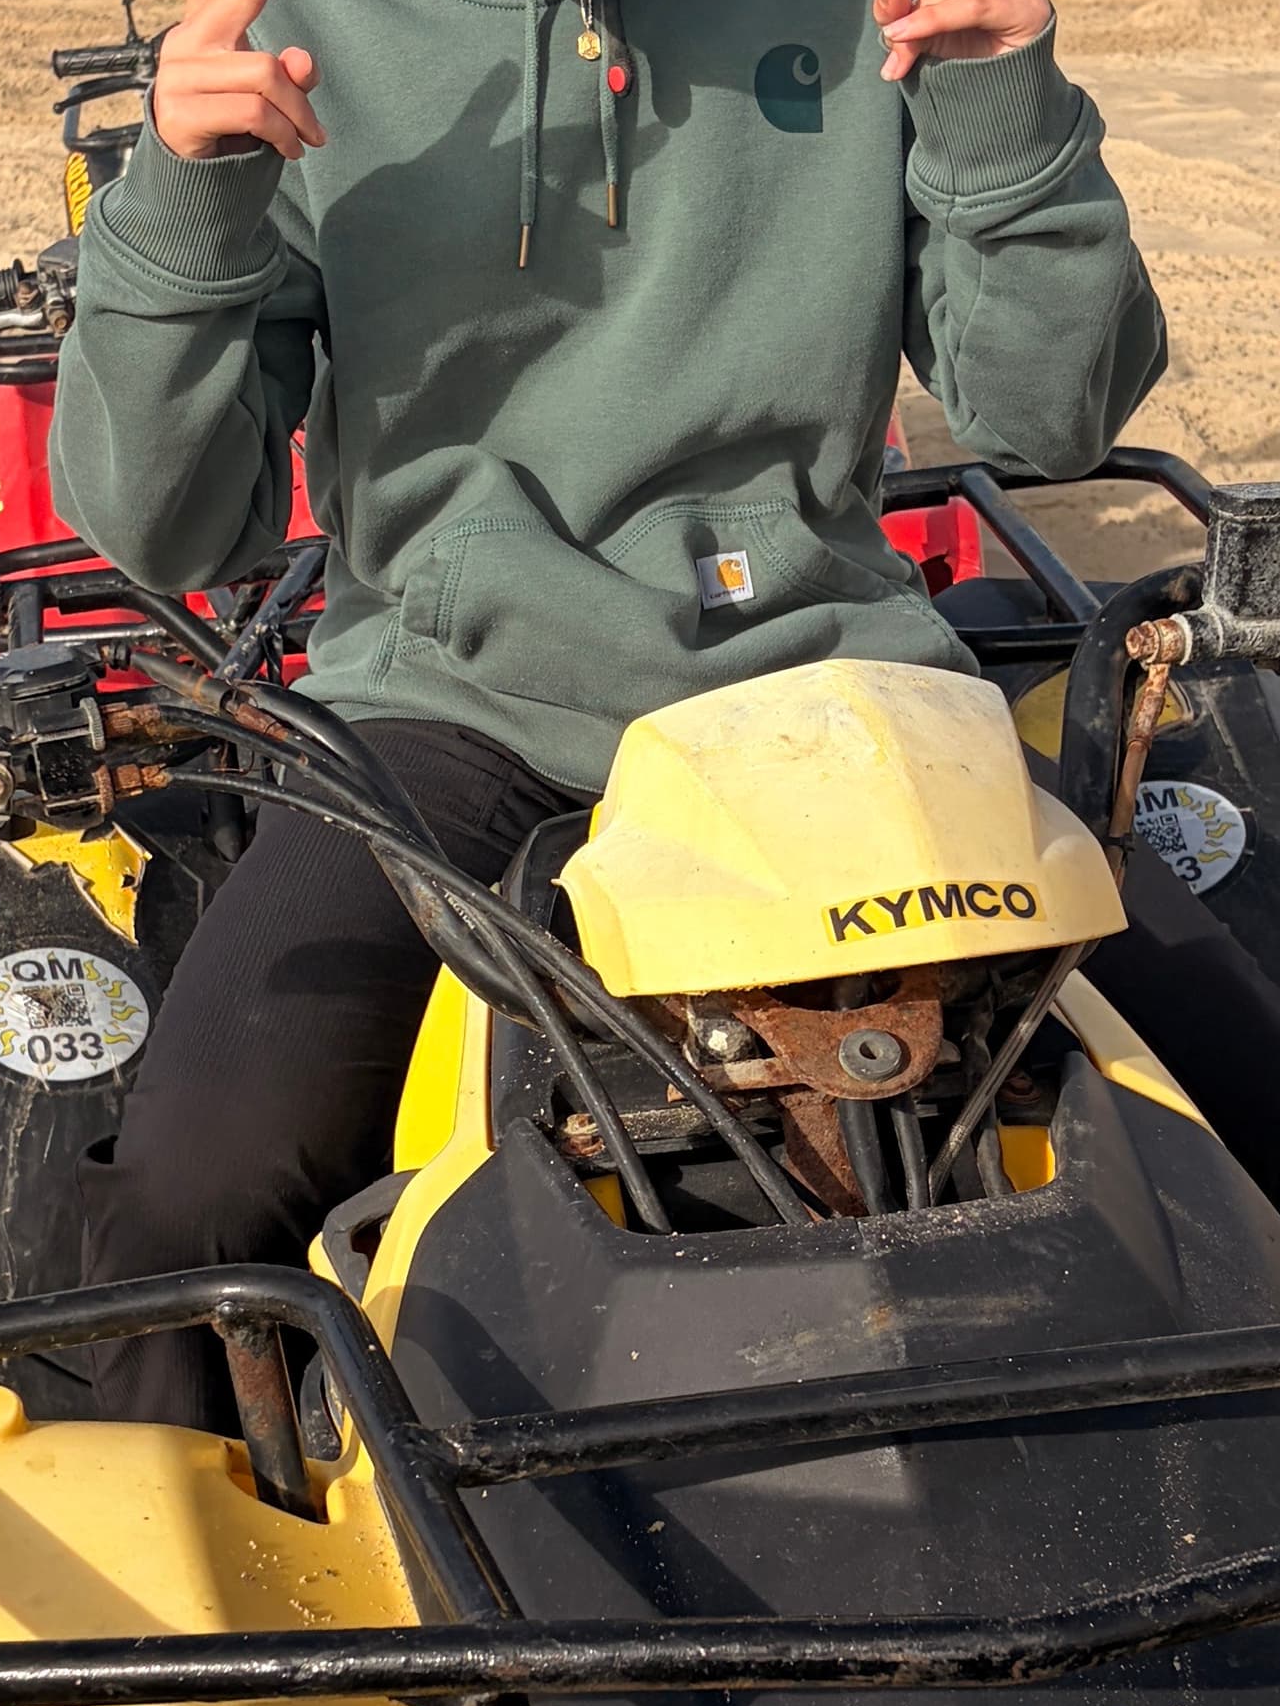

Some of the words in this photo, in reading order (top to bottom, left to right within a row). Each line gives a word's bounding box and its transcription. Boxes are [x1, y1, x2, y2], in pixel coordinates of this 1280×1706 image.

[829, 883, 1037, 942] KYMCO
[11, 957, 84, 983] QM
[27, 1031, 104, 1065] 033
